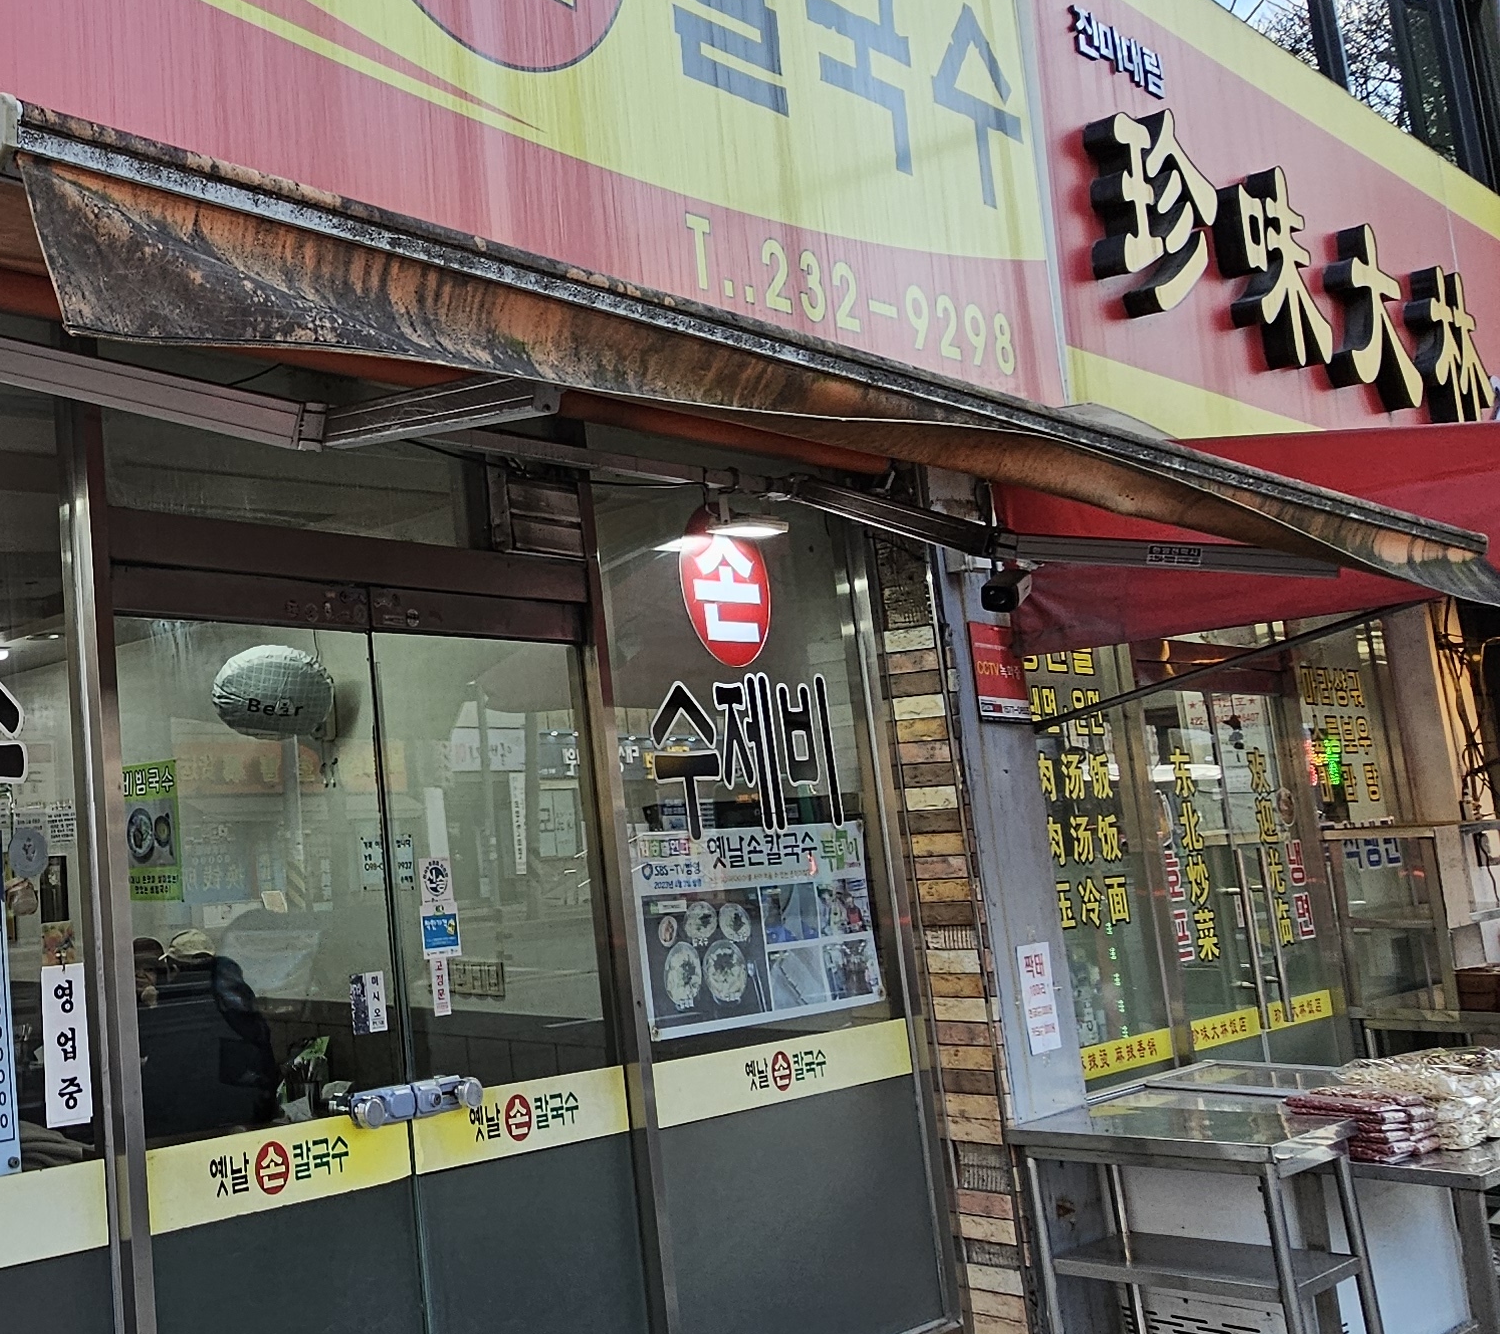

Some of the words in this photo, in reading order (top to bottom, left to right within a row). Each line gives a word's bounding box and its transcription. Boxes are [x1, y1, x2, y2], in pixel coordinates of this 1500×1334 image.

[1083, 109, 1495, 423] 珍味大林
[693, 535, 763, 644] 손
[650, 672, 845, 842] 수제비
[53, 979, 83, 1110] 영업중
[745, 1060, 769, 1093] 옛날
[773, 1053, 791, 1088] 손
[792, 1049, 827, 1080] 칼국수
[209, 1148, 250, 1198] 옛날
[258, 1145, 287, 1190] 손
[292, 1134, 350, 1182] 칼국수
[469, 1098, 501, 1142] 옛날
[506, 1097, 532, 1136] 손
[533, 1091, 580, 1130] 칼국수
